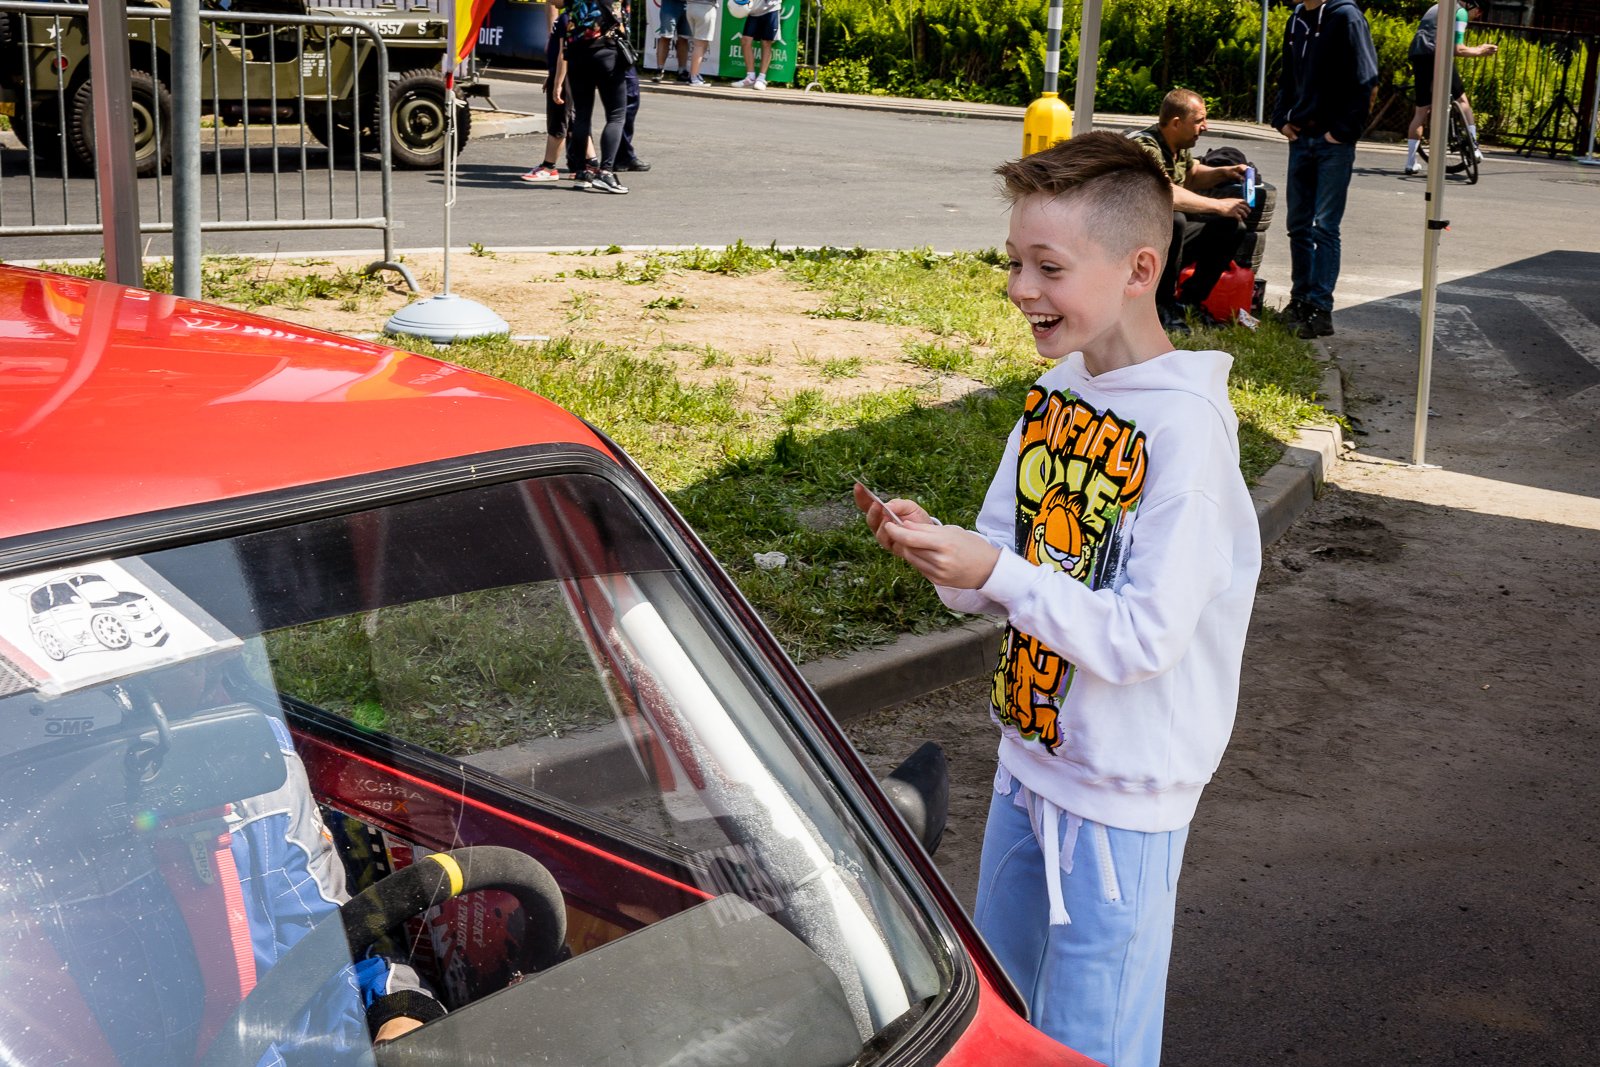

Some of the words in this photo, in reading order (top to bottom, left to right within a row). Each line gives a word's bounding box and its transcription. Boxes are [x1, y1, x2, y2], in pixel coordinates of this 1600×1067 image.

[479, 27, 504, 46] DIFF
[728, 45, 762, 60] JELIA
[44, 719, 95, 735] OMP
